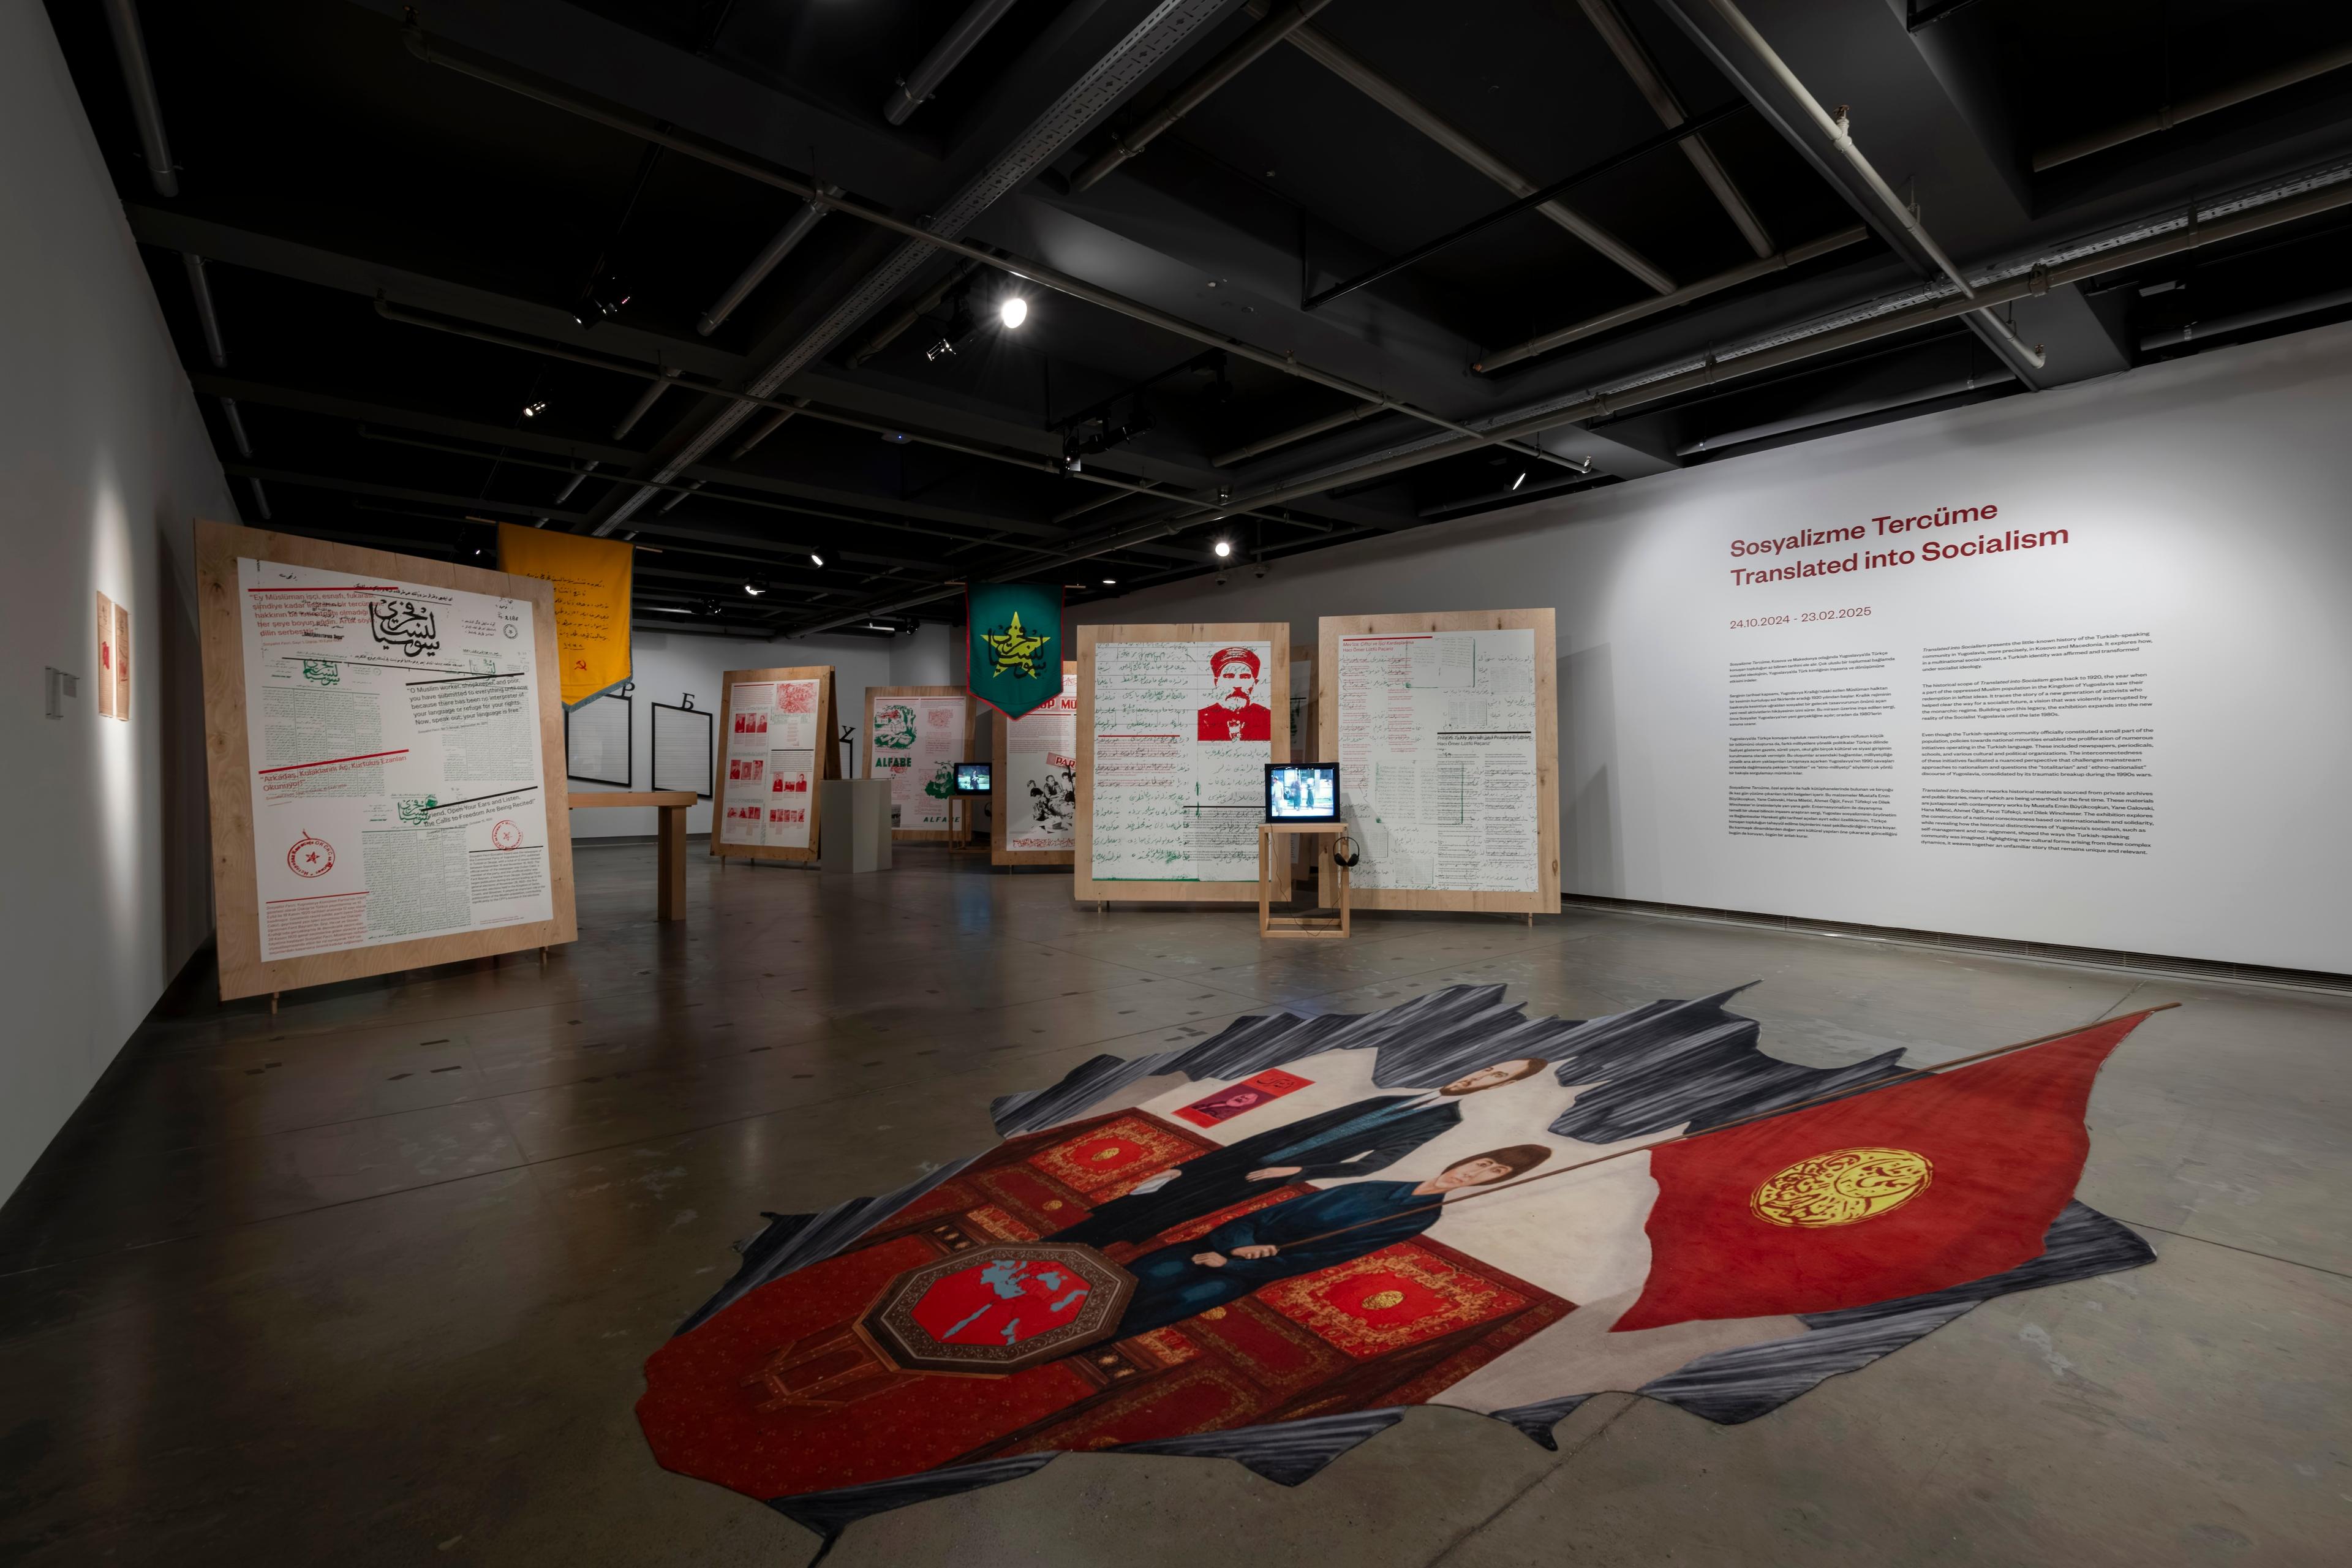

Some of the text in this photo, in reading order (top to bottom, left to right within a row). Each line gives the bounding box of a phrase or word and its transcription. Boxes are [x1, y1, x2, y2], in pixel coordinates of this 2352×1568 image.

[1730, 503, 1999, 559] Sosyalizme Tercüme
[1730, 529, 2070, 586] Translated into Socialism
[1729, 614, 1791, 630] 24.10.2024
[1801, 606, 1871, 623] 23.02.2025
[489, 693, 518, 701] interpreter
[428, 707, 455, 716] language
[875, 757, 912, 767] ALFABE
[459, 811, 484, 820] Freedom
